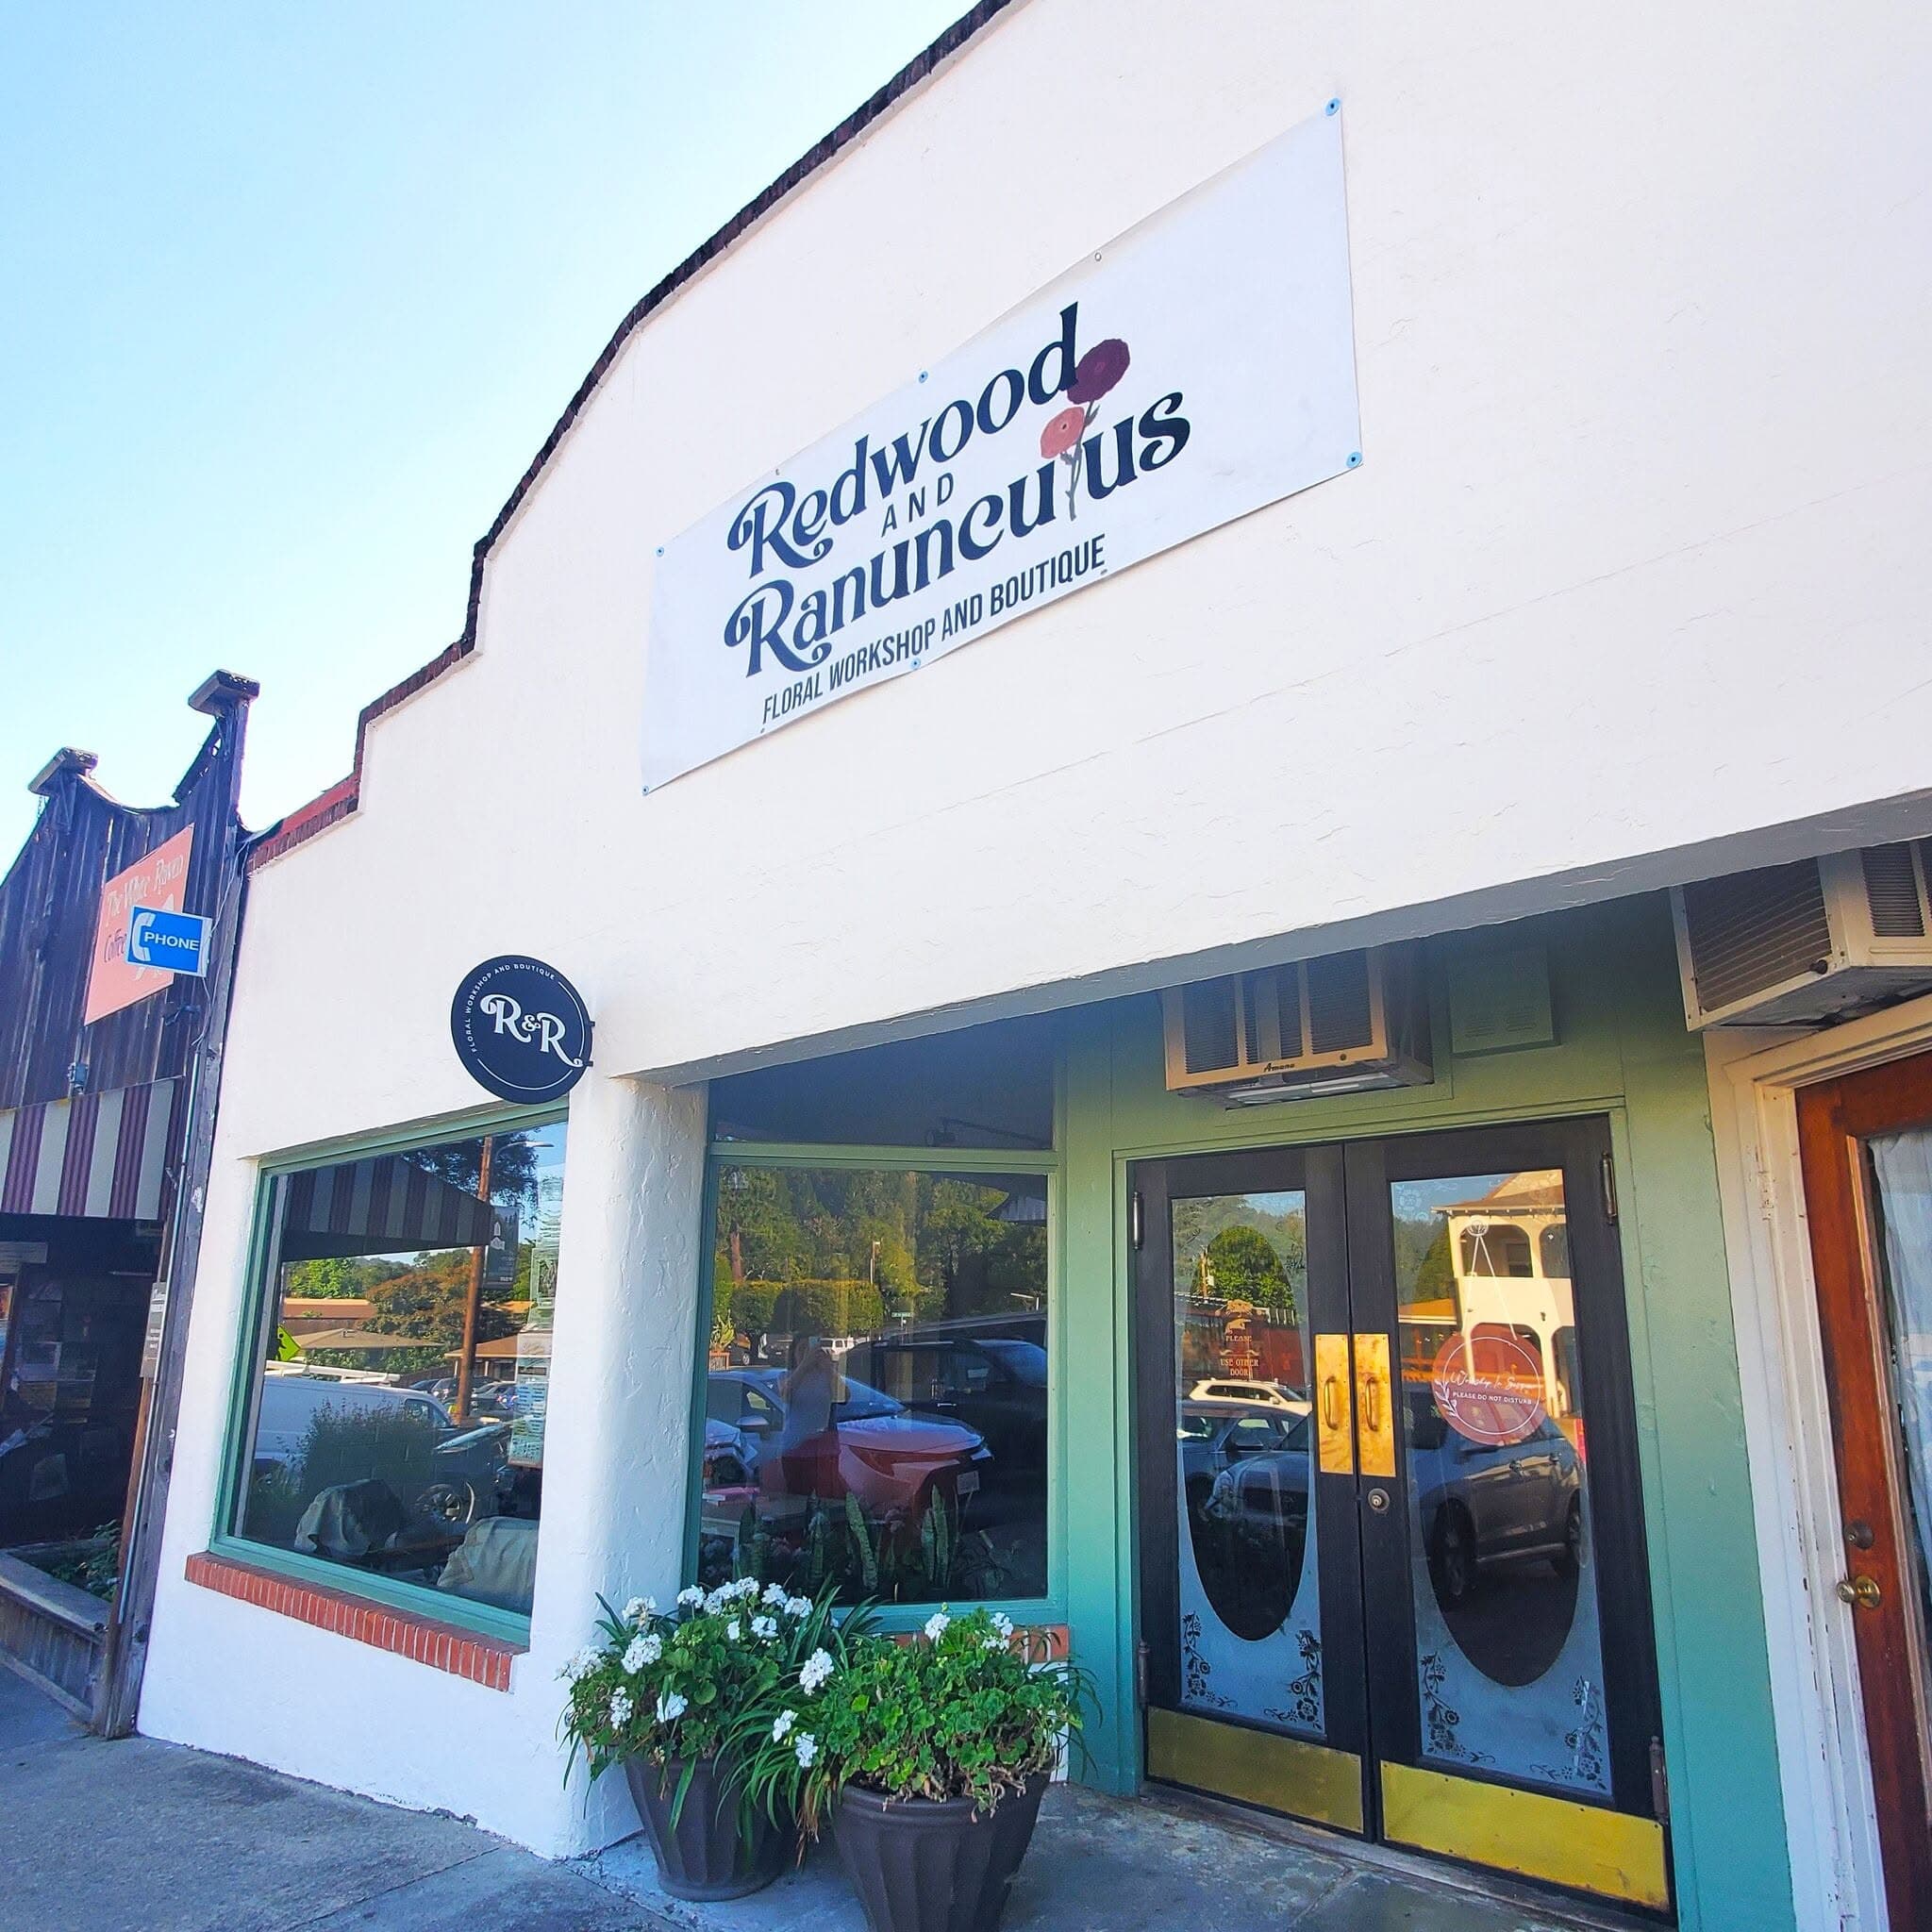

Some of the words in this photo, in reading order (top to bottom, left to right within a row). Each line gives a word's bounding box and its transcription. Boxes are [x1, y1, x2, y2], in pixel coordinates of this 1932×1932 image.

[727, 301, 1079, 578] Redwood
[881, 472, 956, 538] AND
[761, 667, 824, 724] FLORAL
[828, 618, 936, 691] WORKSHOP
[941, 592, 983, 641] AND
[990, 533, 1106, 618] BOUTIQUE
[143, 931, 200, 951] PHONE
[493, 963, 511, 975] AND
[513, 962, 556, 981] BOUTIQUE
[464, 972, 492, 1014] WORKSHOP
[465, 1018, 477, 1054] FLORAL
[479, 993, 584, 1068] R&R
[1220, 1357, 1234, 1367] USE
[1235, 1357, 1259, 1367] OTHER
[1229, 1368, 1248, 1376] DOOR
